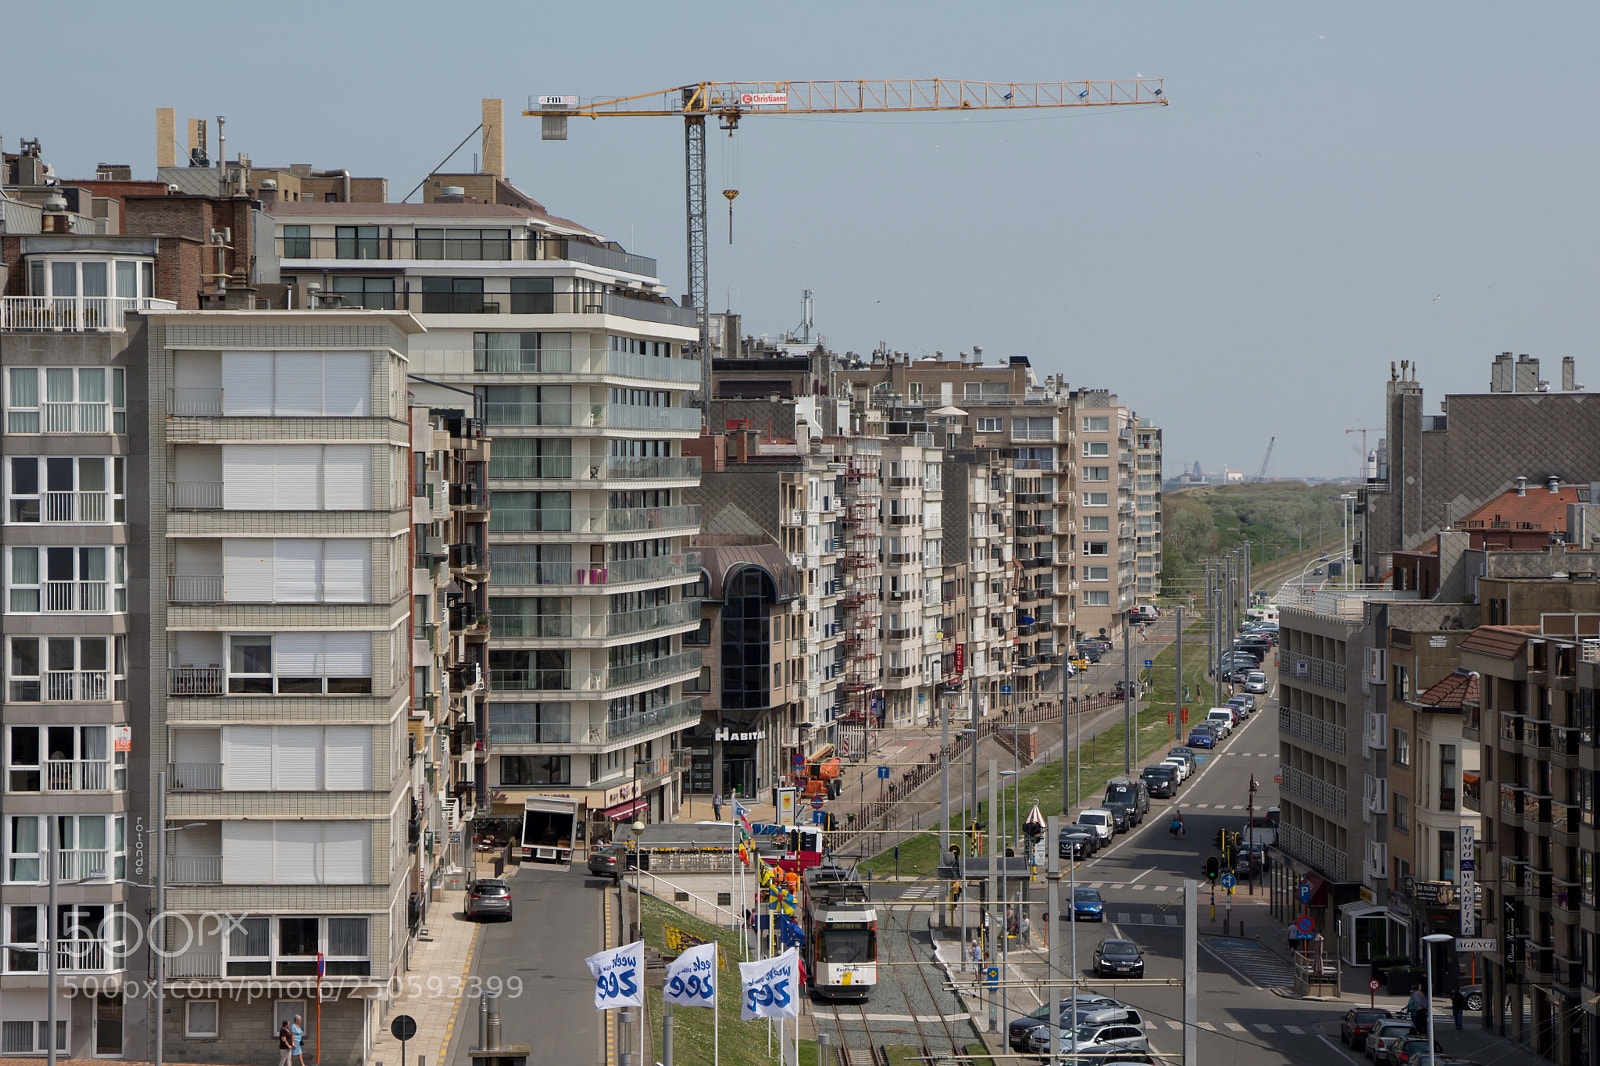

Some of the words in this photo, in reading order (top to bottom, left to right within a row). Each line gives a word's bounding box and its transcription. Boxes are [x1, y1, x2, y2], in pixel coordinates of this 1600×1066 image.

[753, 95, 786, 103] Christiaens
[135, 816, 144, 875] rotonde
[1462, 829, 1472, 858] IMMO
[1301, 886, 1309, 897] P
[1462, 873, 1472, 934] WENDUINE
[1457, 941, 1496, 949] AGENCE
